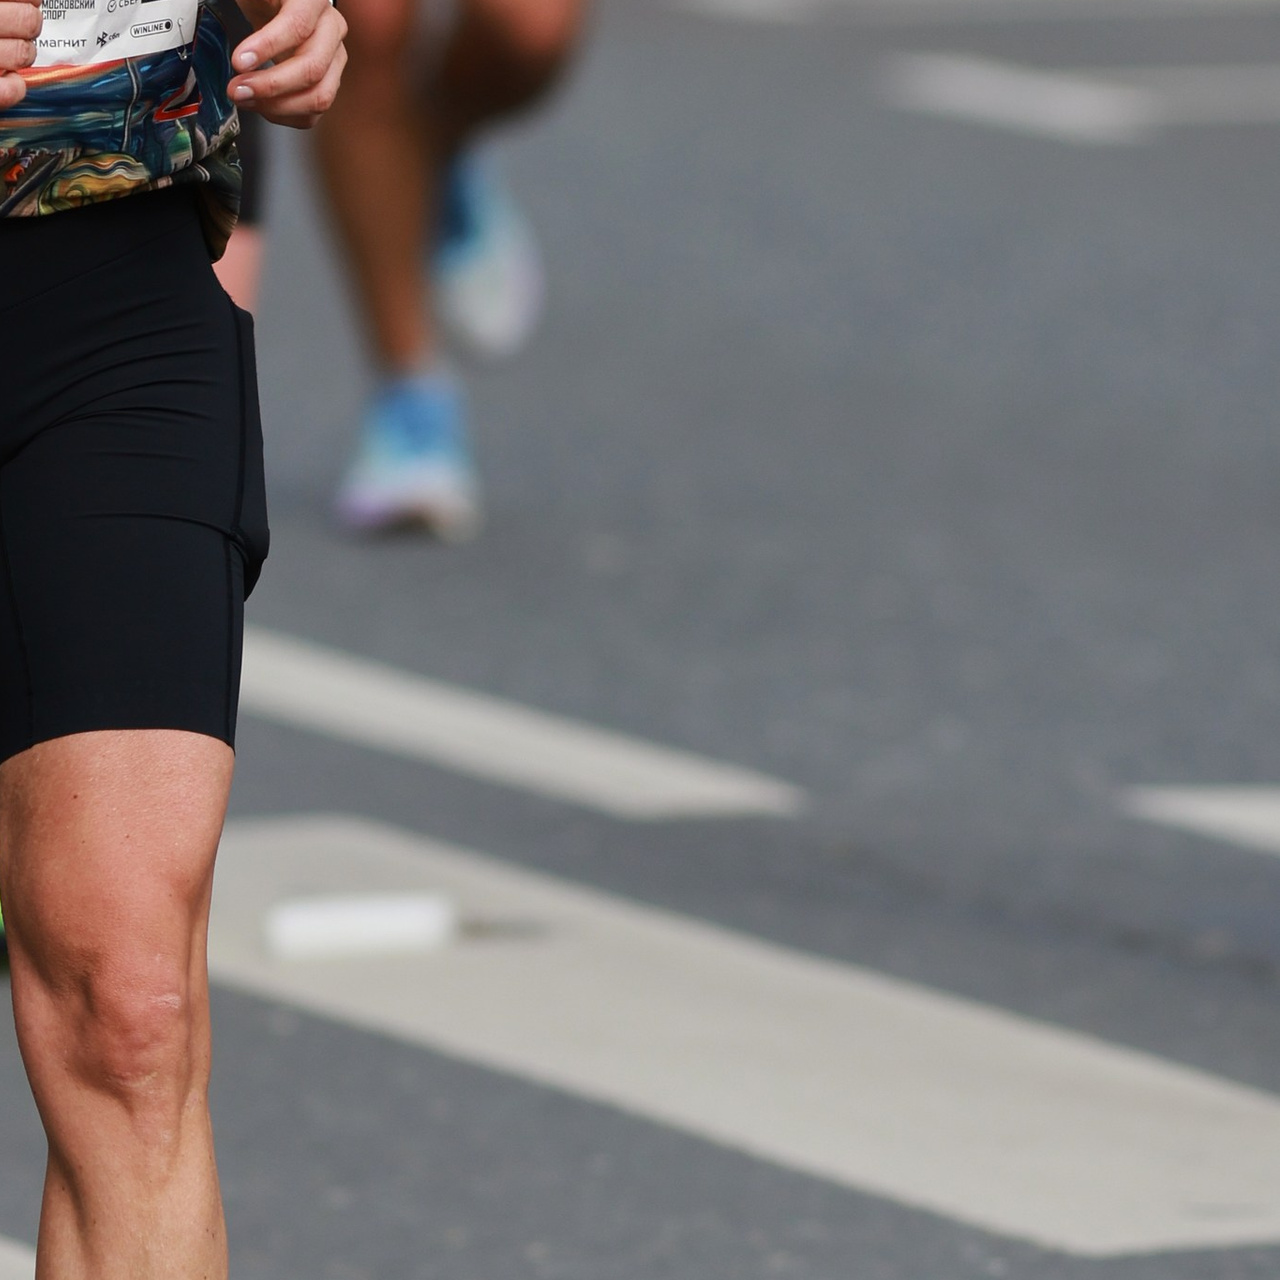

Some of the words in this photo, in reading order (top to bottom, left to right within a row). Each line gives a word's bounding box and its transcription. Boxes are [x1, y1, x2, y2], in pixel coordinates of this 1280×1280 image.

[42, 9, 66, 20] СПОРТ
[133, 23, 163, 35] WINLINE
[39, 38, 87, 48] магнит
